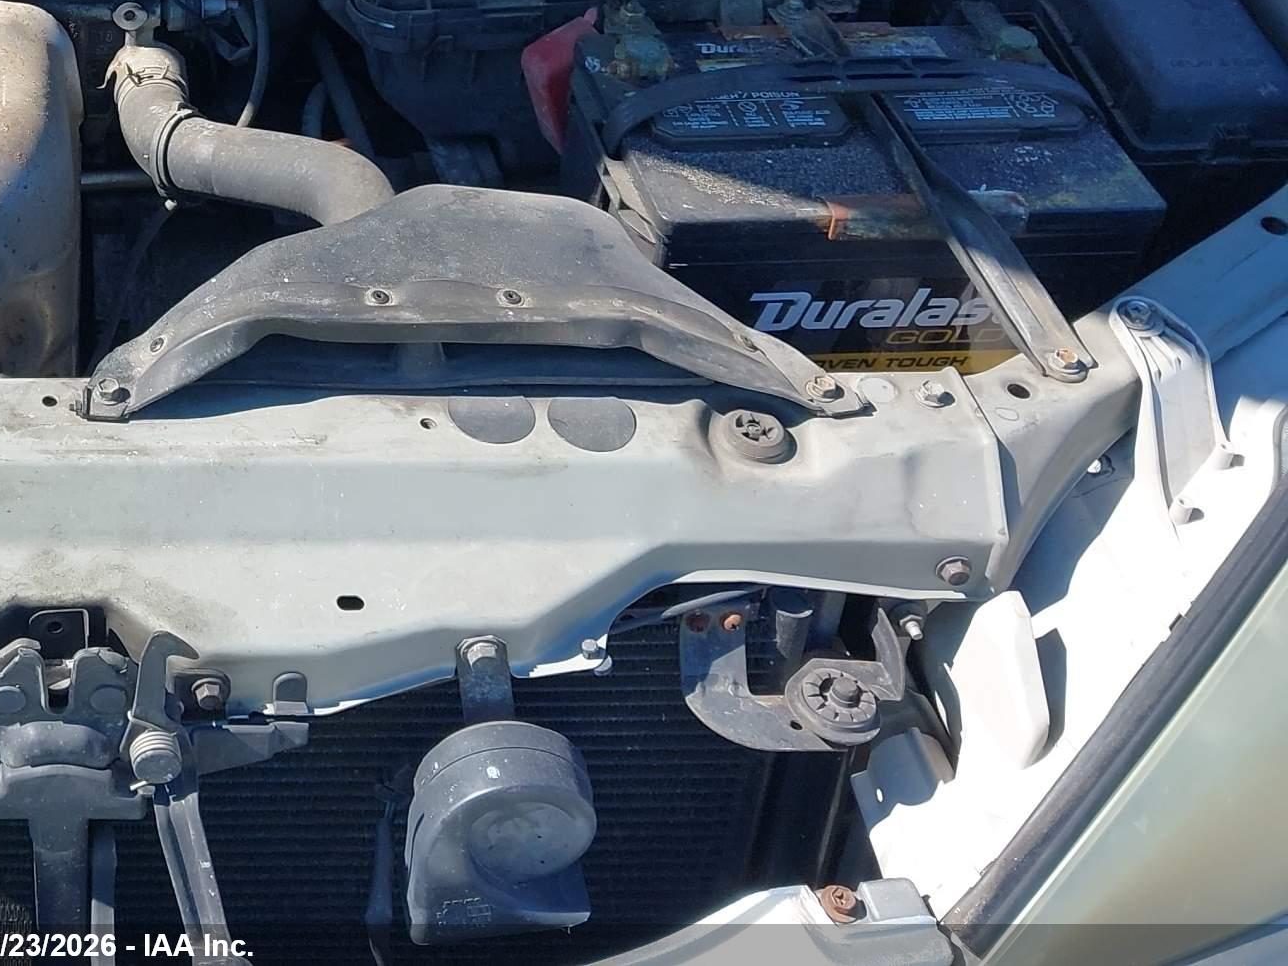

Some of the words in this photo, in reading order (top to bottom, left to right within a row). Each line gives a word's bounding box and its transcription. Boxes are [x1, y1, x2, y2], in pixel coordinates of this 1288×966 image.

[749, 287, 1002, 332] Duralas
[886, 328, 1007, 345] GOLD
[884, 356, 969, 370] TOUGH
